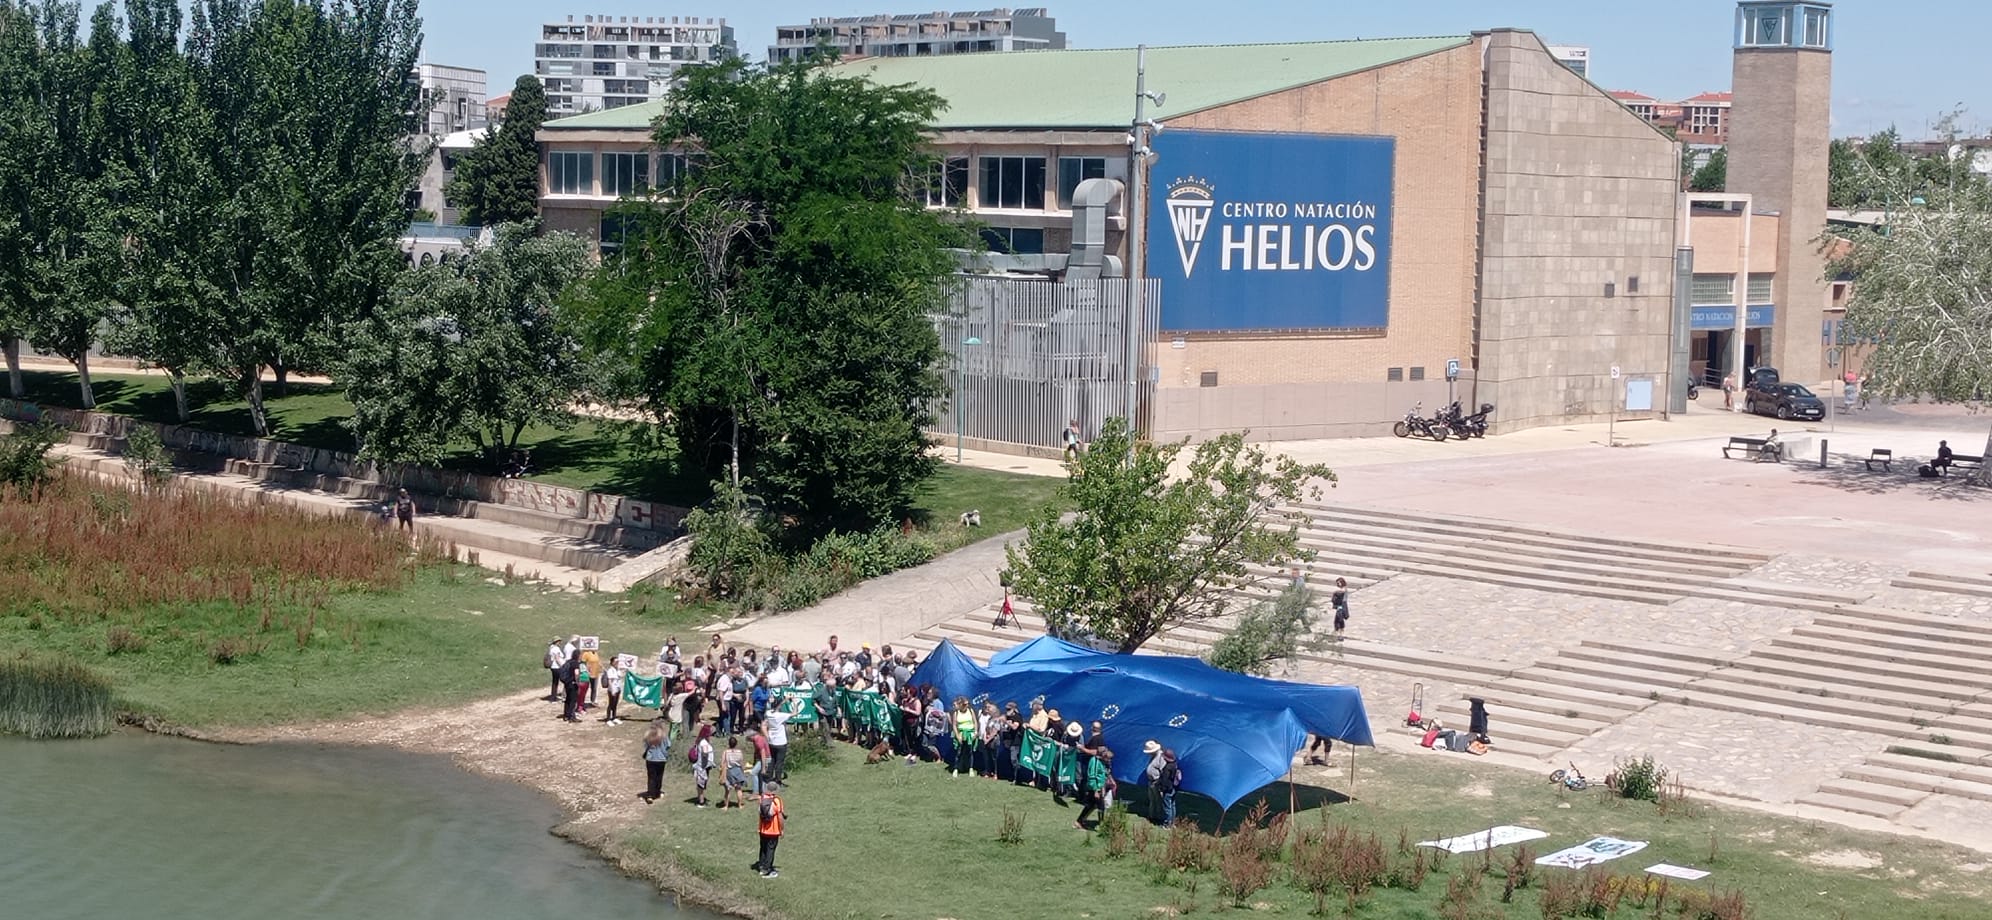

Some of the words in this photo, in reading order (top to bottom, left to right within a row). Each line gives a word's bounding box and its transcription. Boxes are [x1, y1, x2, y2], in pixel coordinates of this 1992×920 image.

[1223, 202, 1287, 218] CENTRO
[1294, 200, 1376, 219] NATACIÓN
[1221, 223, 1376, 271] HELIOS
